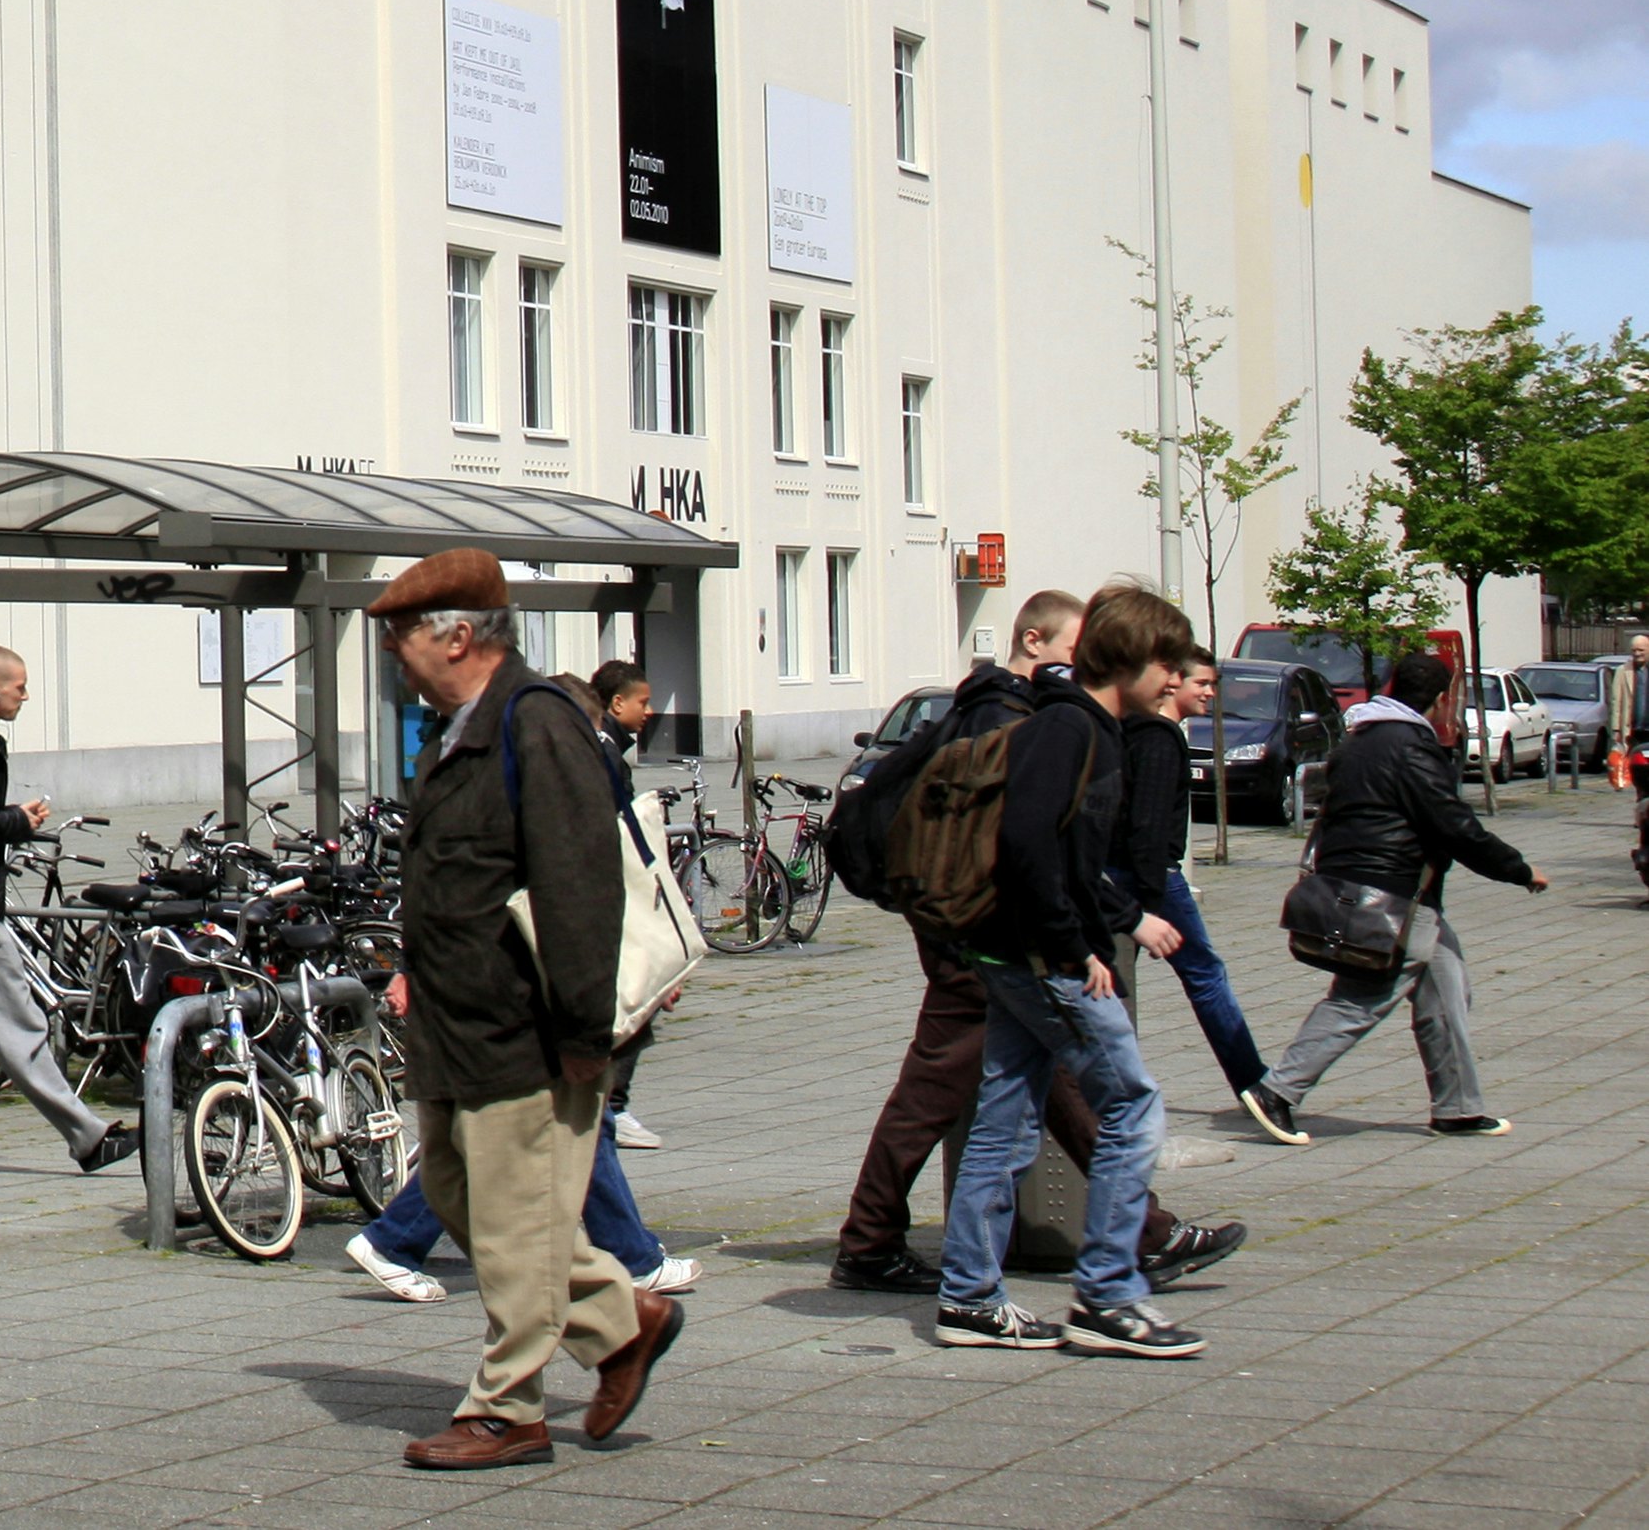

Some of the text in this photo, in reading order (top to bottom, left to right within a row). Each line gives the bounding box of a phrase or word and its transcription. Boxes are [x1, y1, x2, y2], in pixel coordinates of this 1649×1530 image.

[628, 147, 665, 174] Animism
[629, 199, 669, 224] 02.05.2010
[660, 467, 706, 522] HKA
